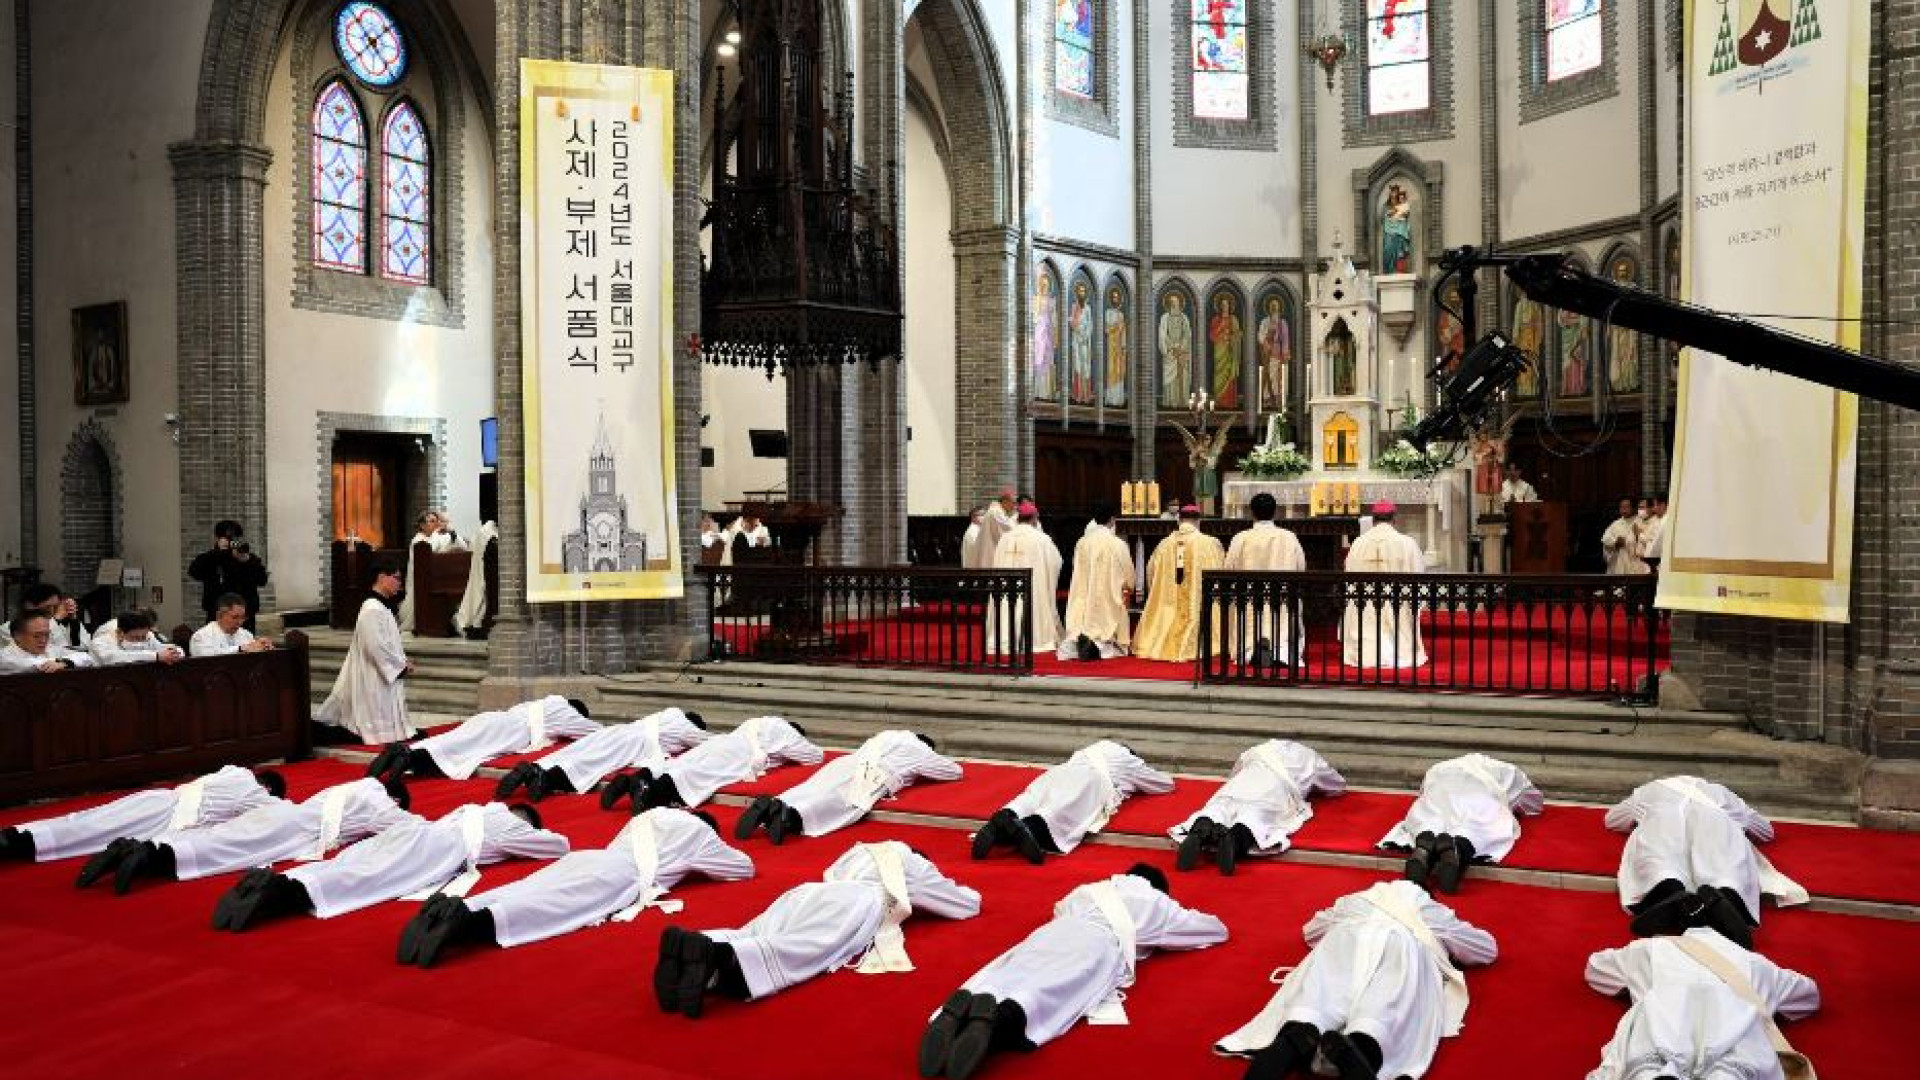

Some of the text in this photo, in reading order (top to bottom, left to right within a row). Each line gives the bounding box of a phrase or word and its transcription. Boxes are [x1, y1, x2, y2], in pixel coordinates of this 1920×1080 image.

[565, 273, 598, 373] 서품식
[611, 120, 634, 373] 2024년도 서울대교구
